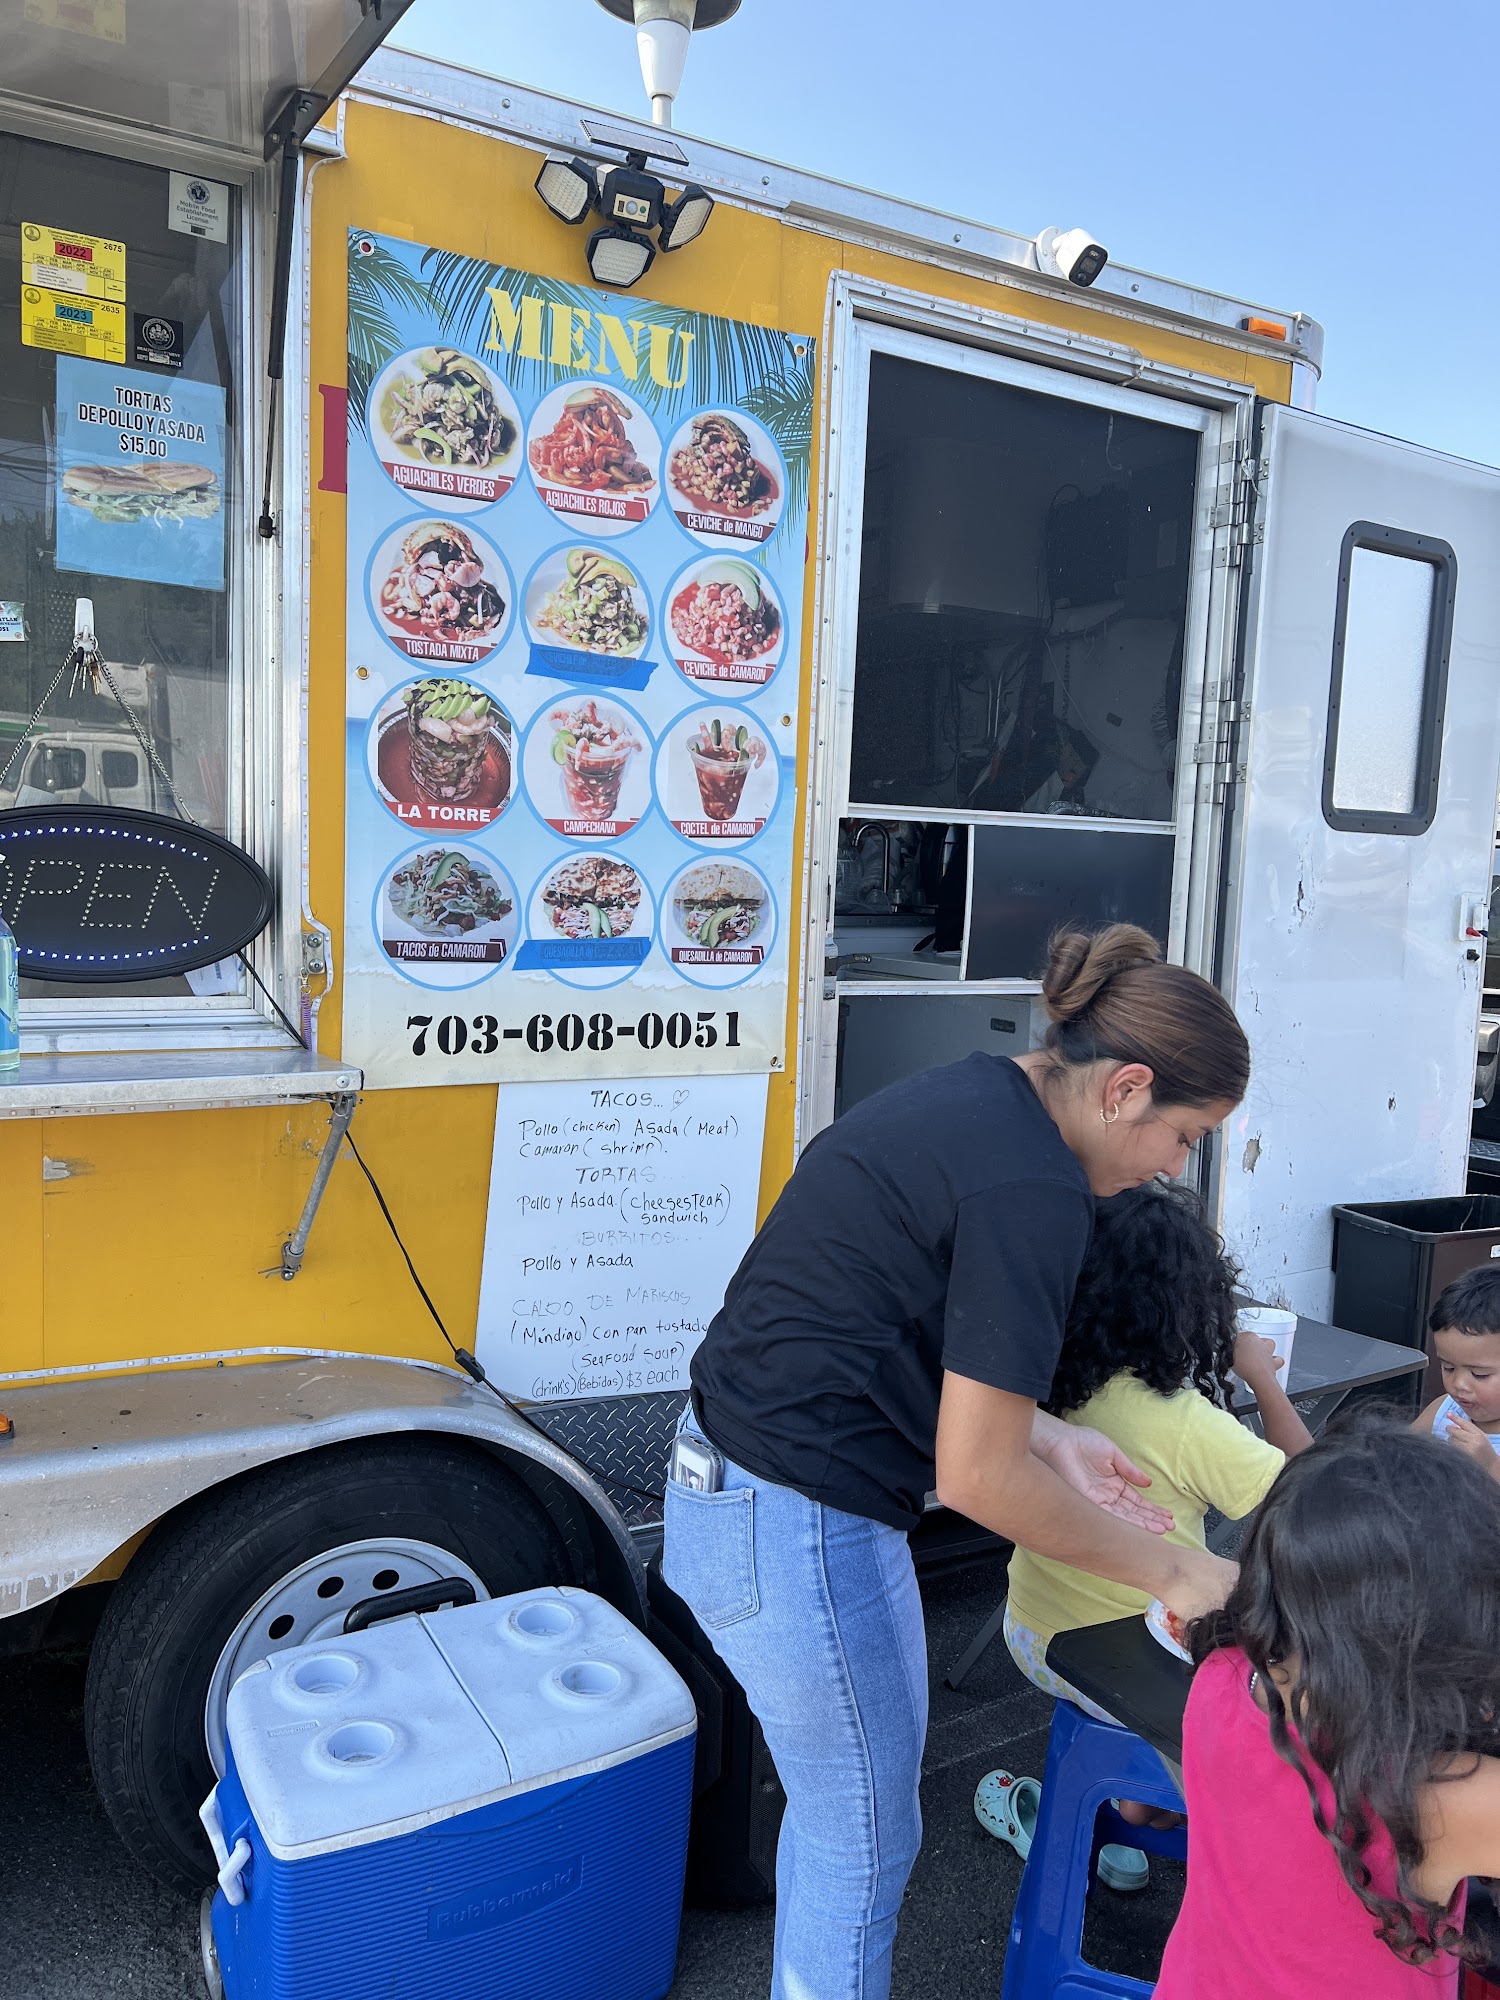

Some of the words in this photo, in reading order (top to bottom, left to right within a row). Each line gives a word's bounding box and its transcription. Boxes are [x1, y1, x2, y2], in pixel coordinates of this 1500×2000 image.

[59, 244, 86, 258] 2022
[103, 242, 122, 252] 2675
[60, 306, 87, 320] 2023
[101, 304, 120, 314] 2635
[484, 286, 695, 389] MENU
[115, 387, 172, 414] TORTAS
[158, 418, 204, 443] ASADA
[120, 433, 167, 458] $15.00
[393, 465, 454, 492] AGUACHILES
[456, 476, 495, 498] VERDES
[546, 490, 596, 514] AGUACHILES
[598, 498, 626, 516] ROJOS
[687, 514, 722, 532] CEVICHE
[724, 520, 732, 532] de
[734, 521, 764, 538] MANGO
[404, 640, 448, 657] TOSTADA
[450, 644, 479, 660] MIXTA
[684, 661, 717, 677] CEVICHE
[718, 664, 728, 678] de
[730, 665, 766, 680] CAMARON
[397, 804, 422, 818] LA
[428, 806, 491, 822] TORRE
[564, 820, 616, 834] CAMPECHANA
[680, 822, 710, 834] COCTEL
[710, 822, 720, 834] de
[722, 822, 756, 834] CAMARON
[396, 942, 426, 957] TACOS
[428, 944, 439, 958] de
[442, 944, 487, 958] CAMARON
[715, 950, 722, 962] de
[406, 1010, 741, 1056] 703-608-0051
[518, 1119, 558, 1140] Pollo
[586, 1252, 634, 1268] Asada
[512, 1299, 574, 1317] CALDO
[586, 1294, 614, 1310] DE
[656, 1317, 708, 1334] tostado
[626, 1370, 642, 1388] $3
[646, 1364, 680, 1385] each
[436, 1868, 574, 1929] Rubbermaid
